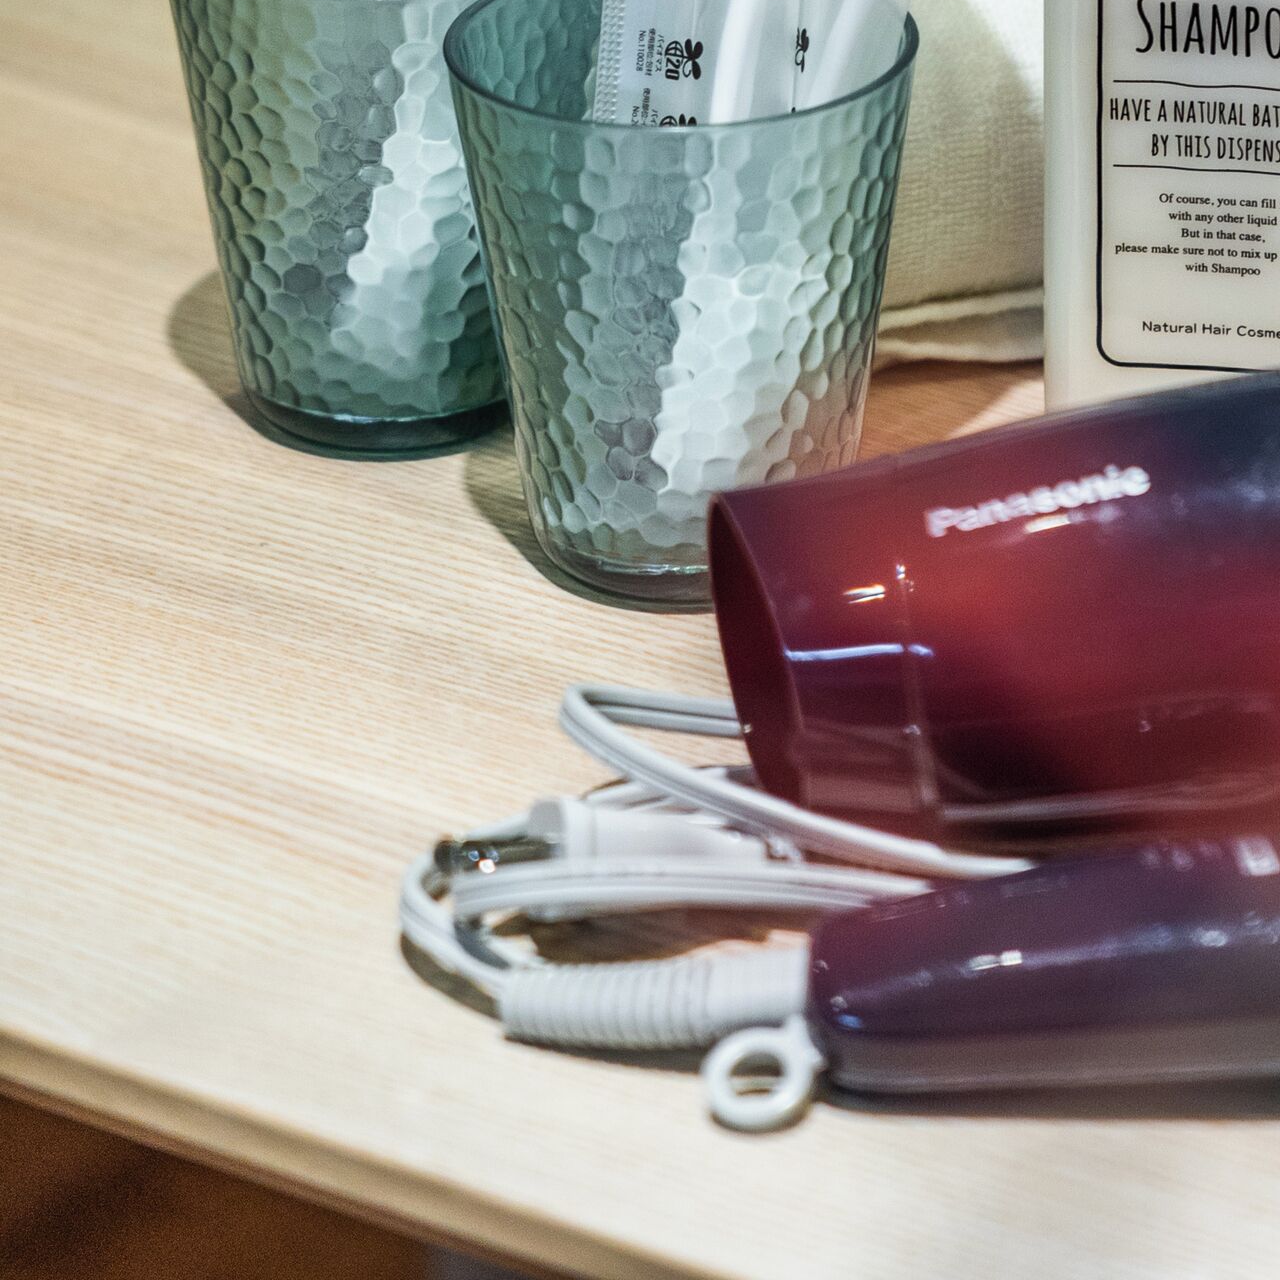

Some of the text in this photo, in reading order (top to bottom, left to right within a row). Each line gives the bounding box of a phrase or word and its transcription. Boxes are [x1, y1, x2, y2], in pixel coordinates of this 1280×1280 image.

[636, 30, 646, 72] No.110028
[655, 34, 665, 72] バイオマス
[665, 57, 681, 81] 20
[1110, 97, 1151, 122] HAVE
[1157, 99, 1168, 123] A
[1173, 100, 1247, 126] NATURAL
[1151, 133, 1169, 157] BY
[1175, 134, 1211, 159] THIS
[1159, 193, 1175, 204] Of
[1175, 196, 1215, 206] course,
[1216, 198, 1237, 208] you
[1239, 199, 1258, 208] can
[1261, 198, 1276, 209] fill
[1168, 210, 1278, 228] with any other liquid
[1181, 228, 1266, 243] But in that case,
[1115, 242, 1148, 255] please
[1151, 244, 1180, 254] make
[1182, 247, 1205, 256] sure
[1207, 248, 1225, 257] not
[1227, 248, 1238, 258] to
[1240, 248, 1261, 259] mix
[1264, 252, 1278, 263] up
[1185, 262, 1261, 277] with Shampoo
[1142, 321, 1197, 334] Natural
[1202, 323, 1232, 335] Hair
